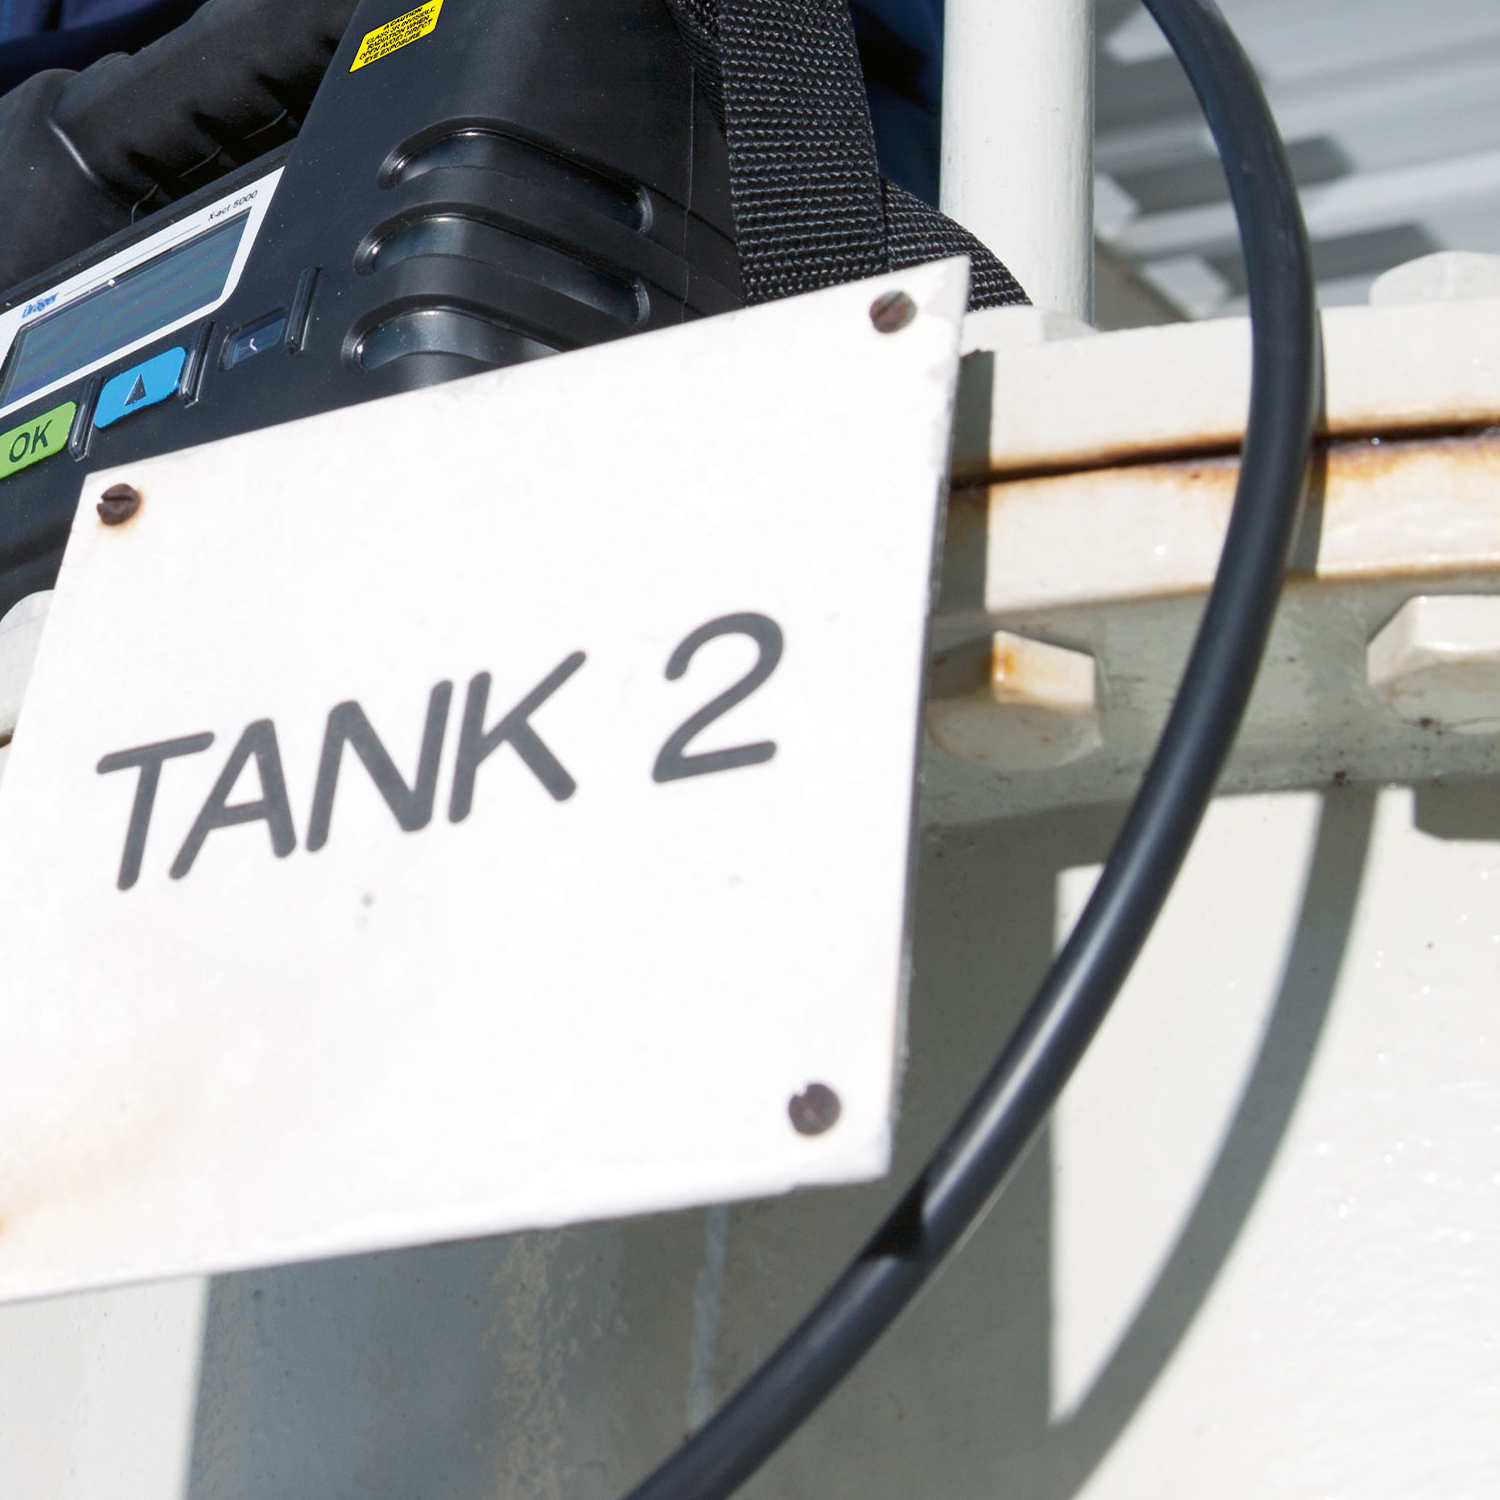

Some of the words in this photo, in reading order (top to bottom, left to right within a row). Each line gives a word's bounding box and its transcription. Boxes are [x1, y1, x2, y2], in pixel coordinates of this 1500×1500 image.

[366, 26, 406, 51] RADIATION
[406, 14, 430, 30] WHEN
[389, 7, 423, 27] CAUTION
[359, 45, 381, 61] OPEN
[380, 33, 404, 49] AVOID
[404, 17, 433, 38] DIRECT
[363, 51, 380, 65] EYE
[379, 30, 422, 57] EXPOSURE
[366, 28, 390, 45] CLASS
[233, 190, 258, 209] 5000
[9, 419, 54, 463] OK
[96, 649, 587, 892] TANK
[651, 610, 785, 784] 2
